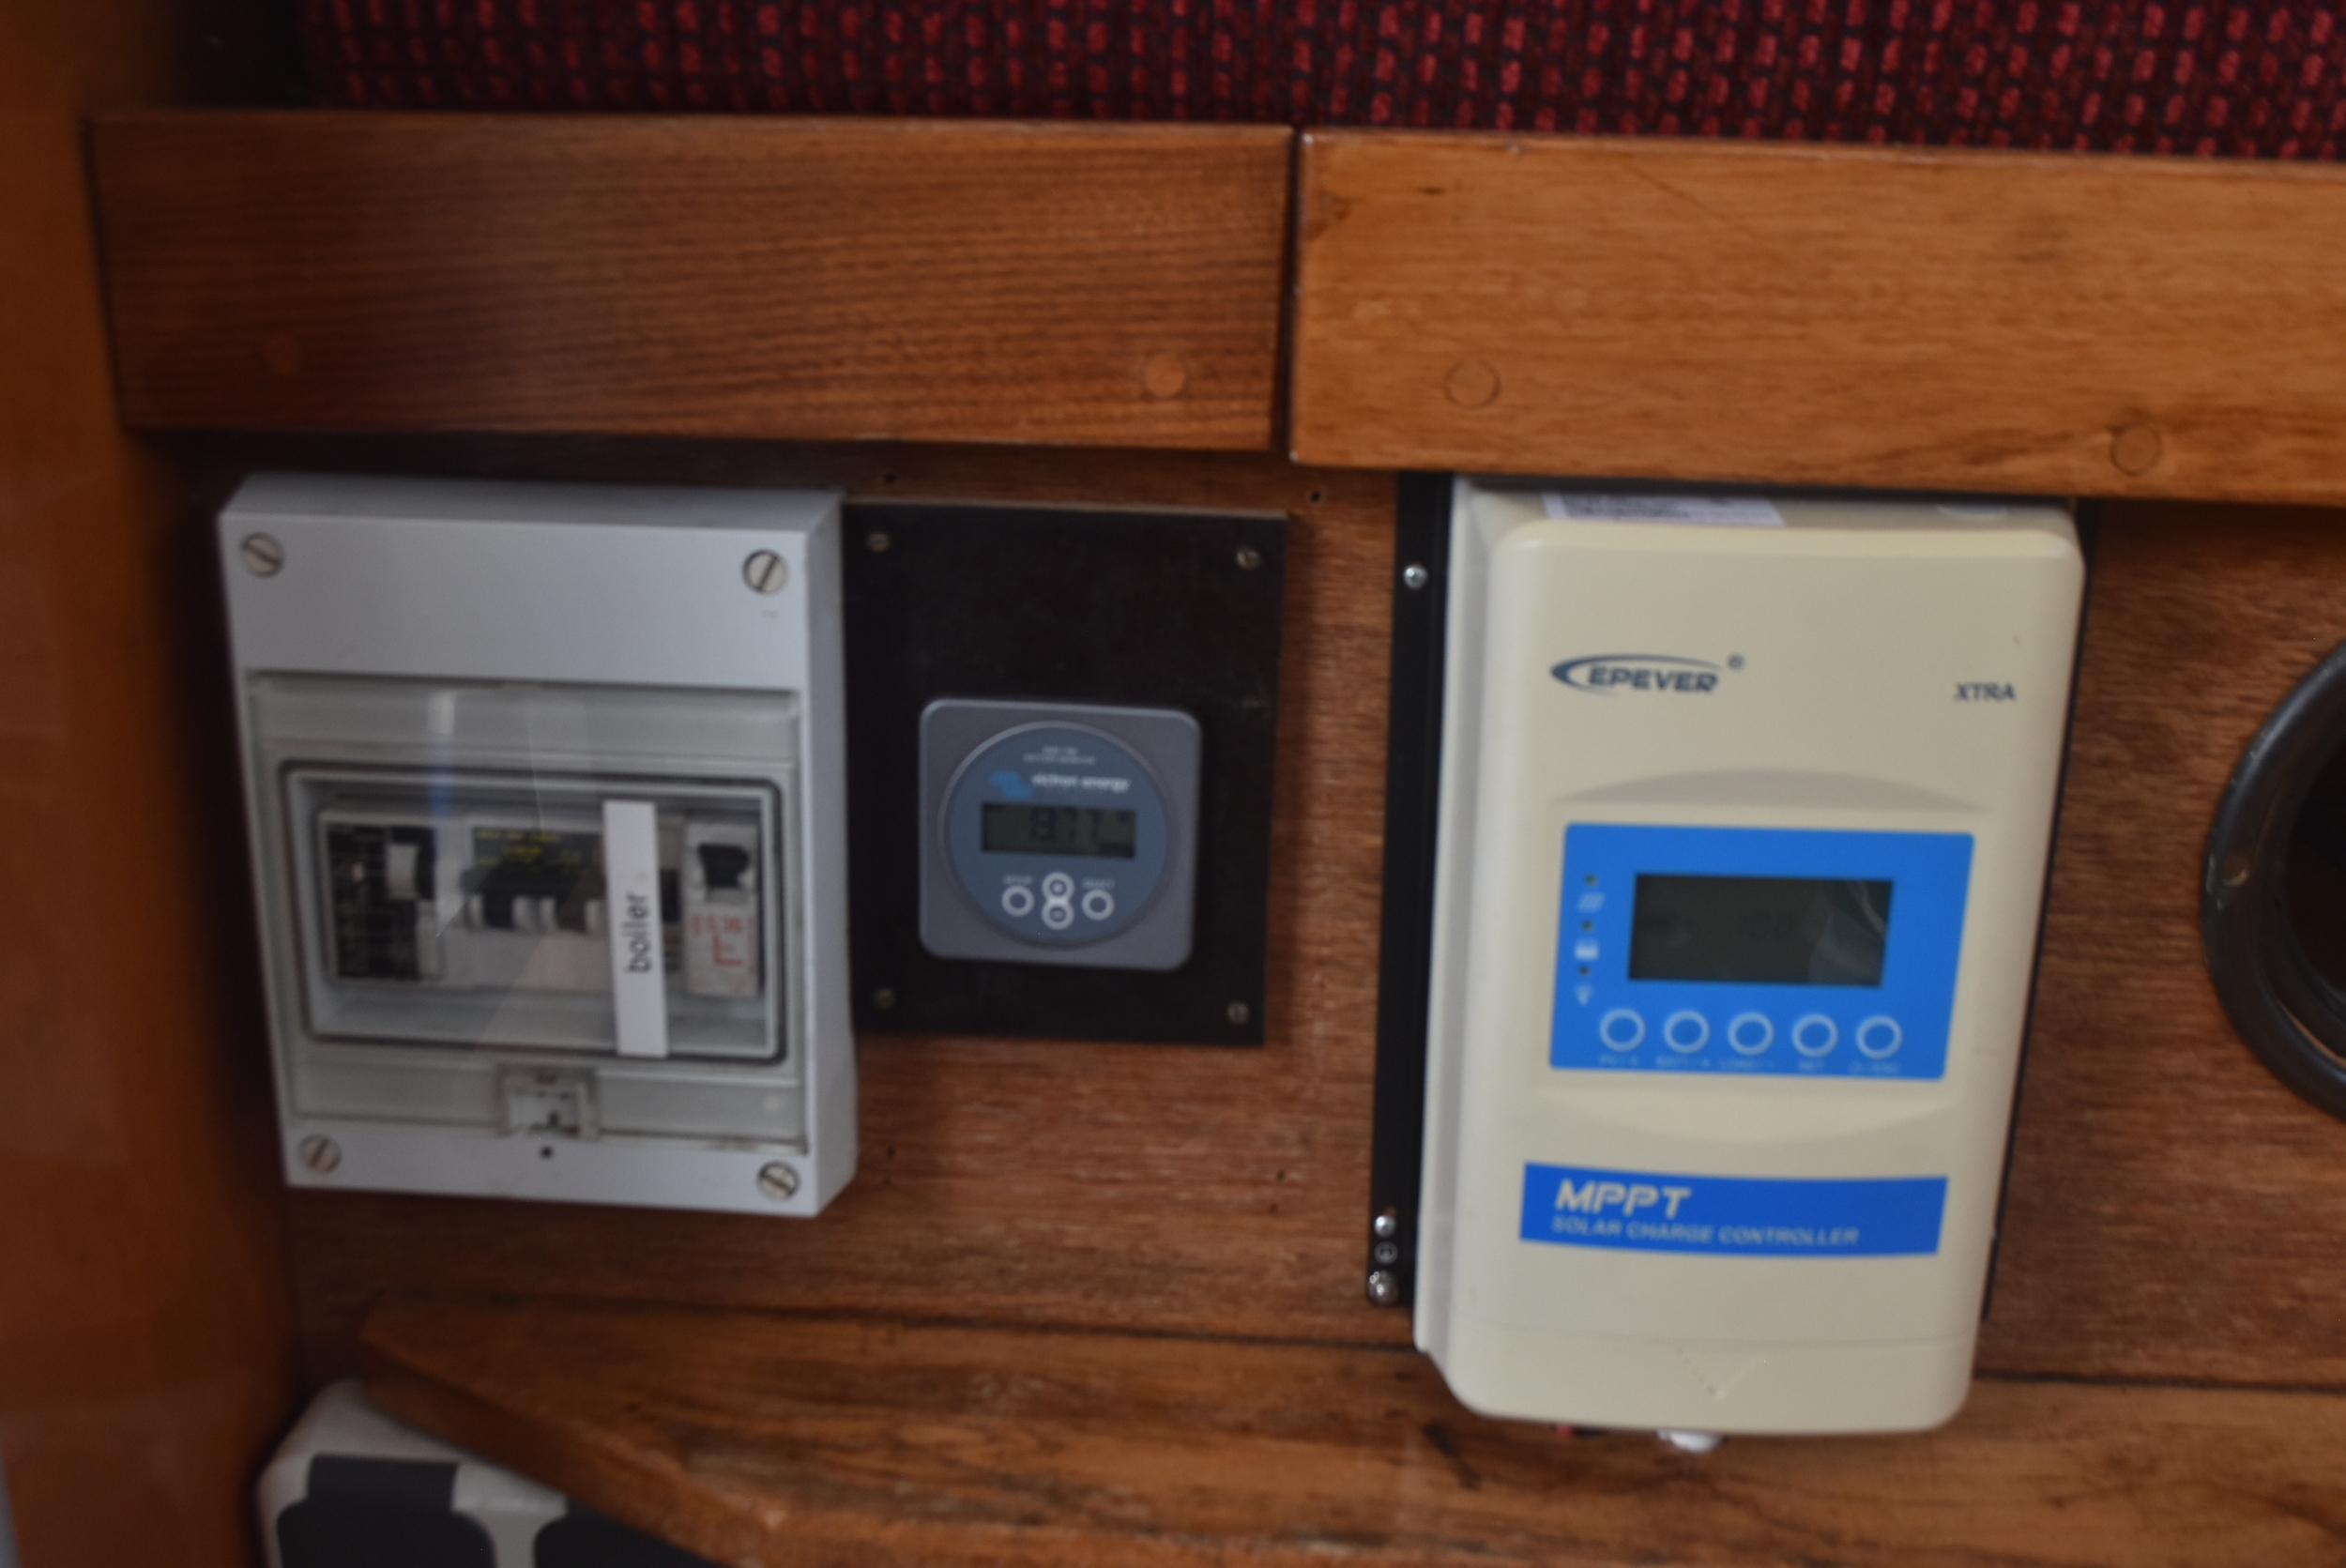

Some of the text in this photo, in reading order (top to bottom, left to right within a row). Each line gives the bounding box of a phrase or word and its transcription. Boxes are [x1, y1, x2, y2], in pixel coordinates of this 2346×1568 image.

[1588, 664, 1719, 695] EPEVER
[1955, 682, 2017, 703] XTRA
[619, 891, 653, 974] boiler
[1554, 1178, 1693, 1220] MPPT
[1551, 1214, 1862, 1247] SOLAR CHARGE CONTROLLER
